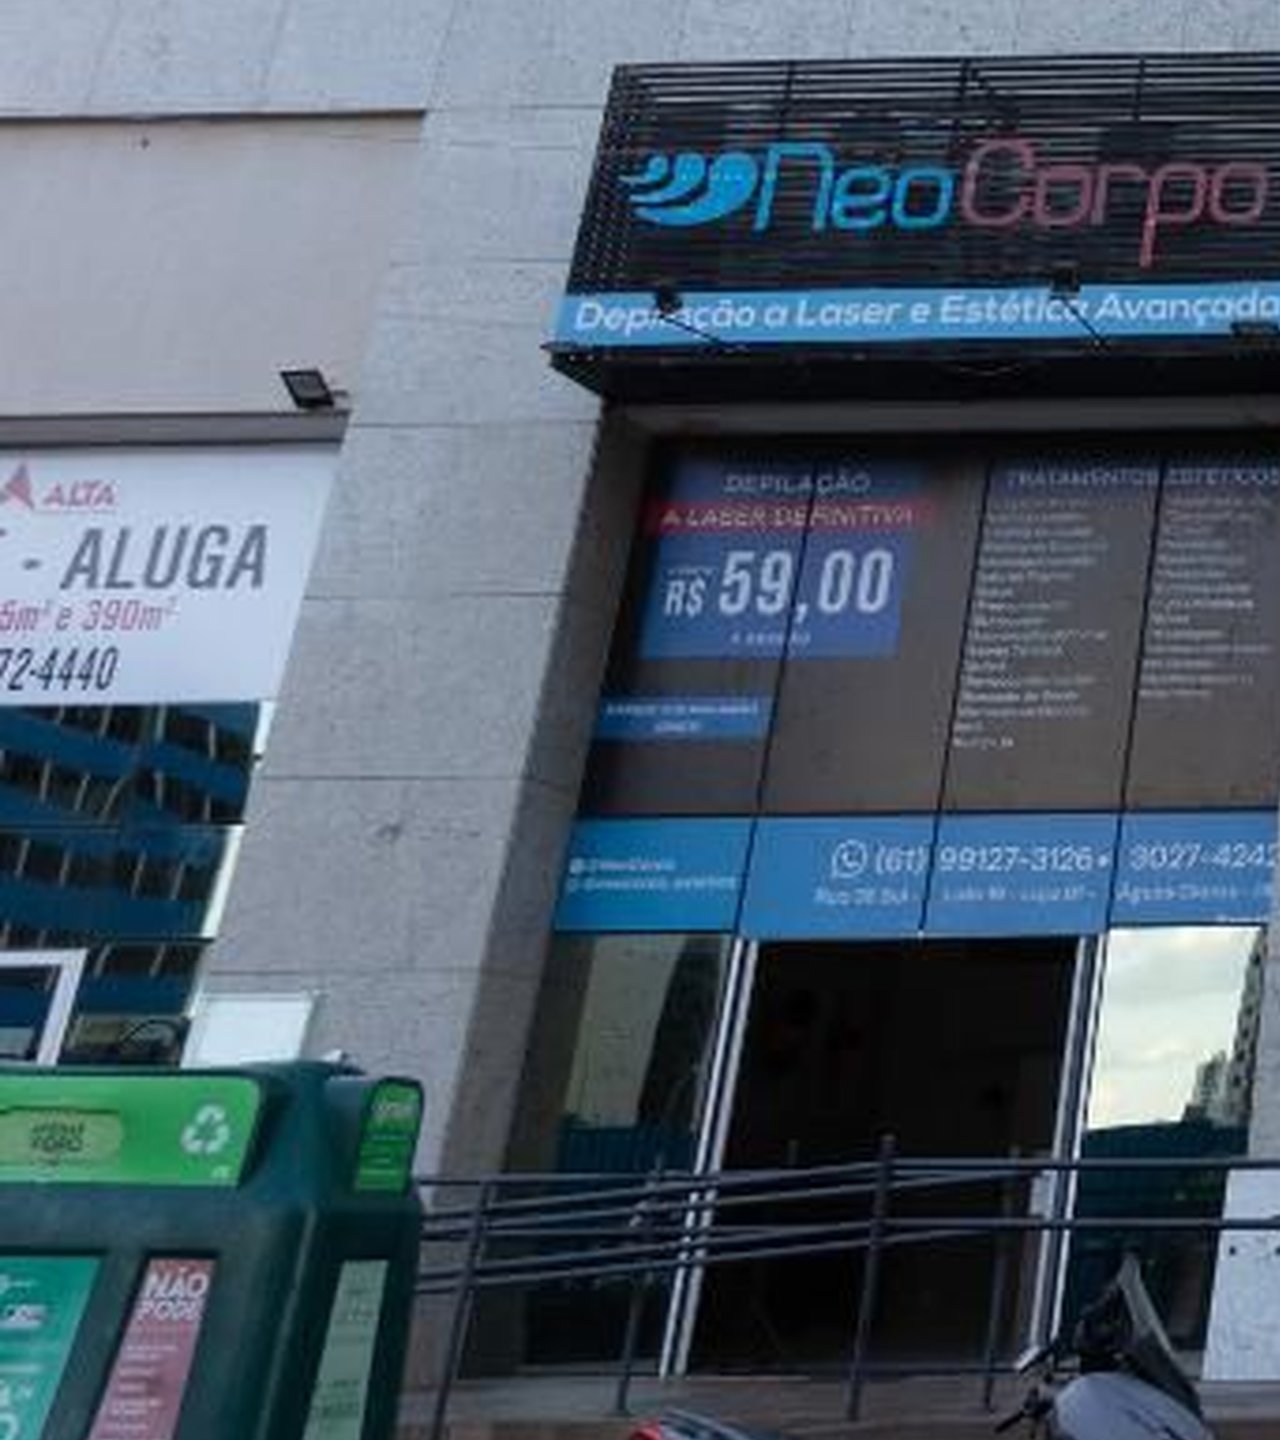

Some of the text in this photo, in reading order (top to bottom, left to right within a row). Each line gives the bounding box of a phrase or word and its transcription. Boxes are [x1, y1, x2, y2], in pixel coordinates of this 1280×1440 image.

[763, 306, 786, 327] a
[799, 298, 903, 326] Laser
[910, 303, 932, 324] e
[939, 292, 1089, 324] Estética
[42, 480, 117, 507] ALTA
[59, 524, 269, 590] ALUGA
[664, 550, 895, 624] R$ 59,00
[873, 842, 926, 876] (61)
[939, 845, 1095, 875] 99127-3126
[143, 1267, 210, 1300] NÃO
